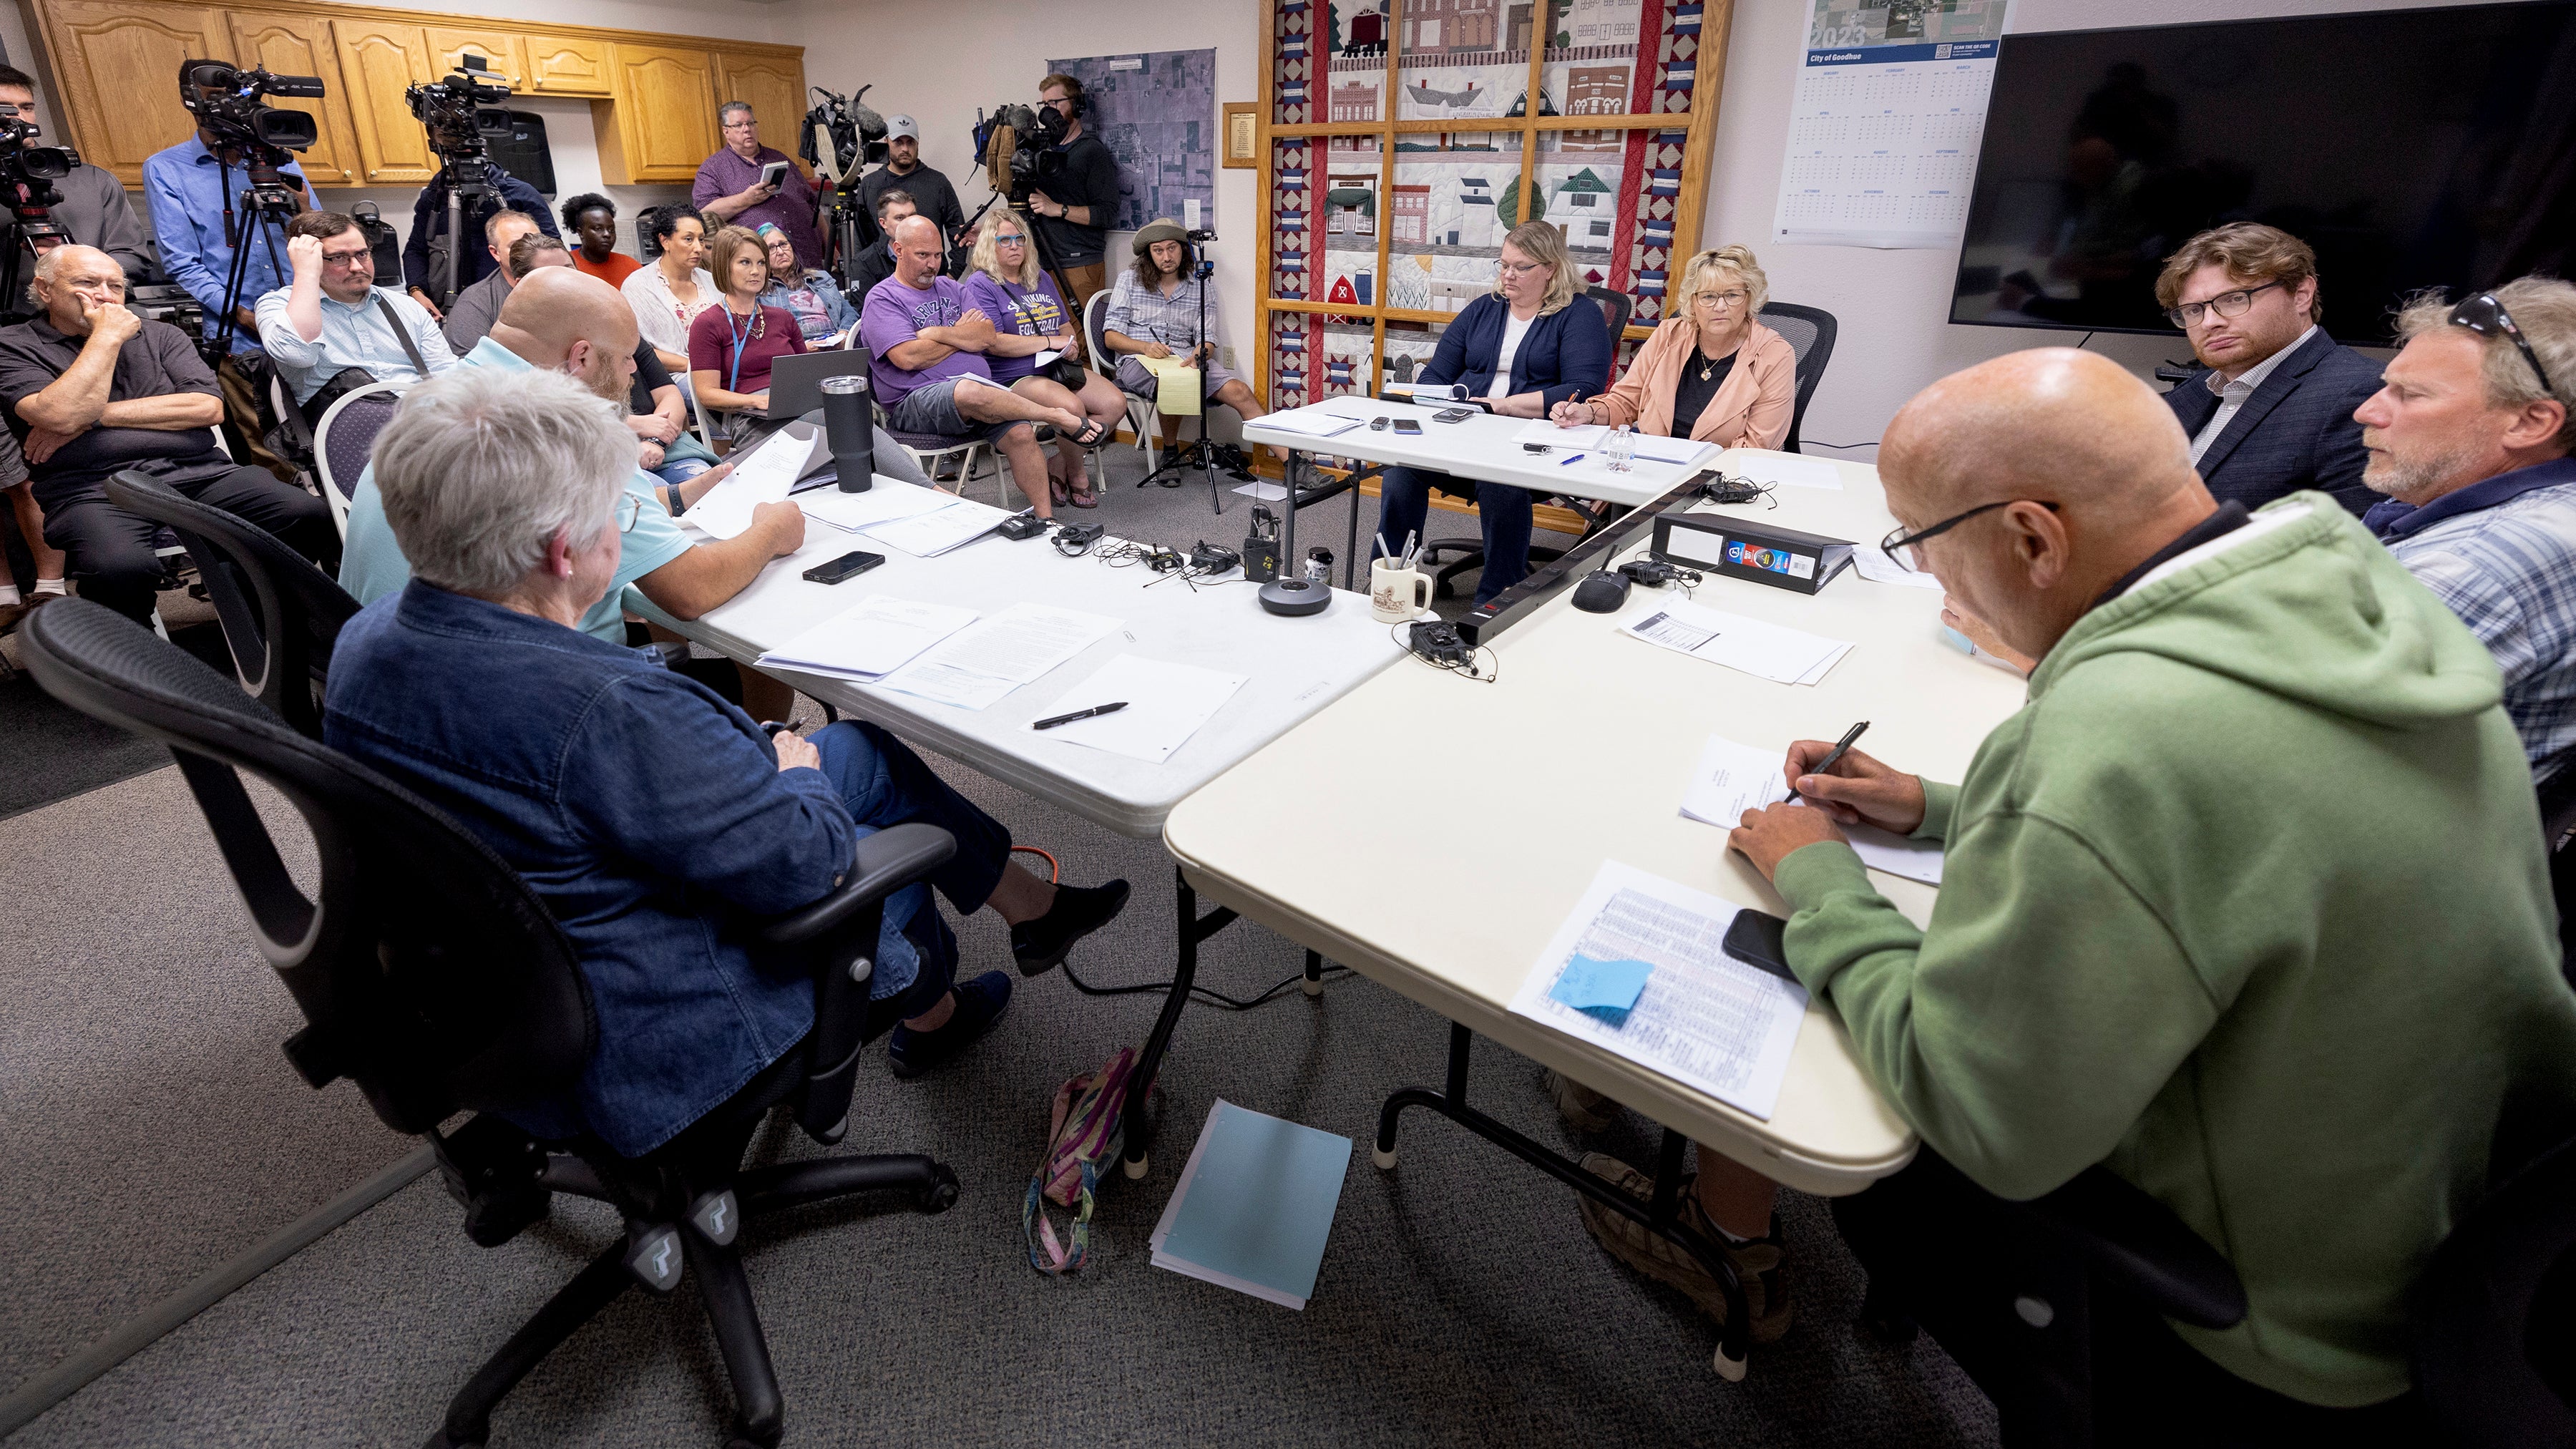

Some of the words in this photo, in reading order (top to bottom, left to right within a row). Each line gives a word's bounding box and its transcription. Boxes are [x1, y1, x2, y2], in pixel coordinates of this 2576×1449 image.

[1810, 25, 1866, 47] 2023
[1810, 55, 1823, 64] City
[1832, 52, 1862, 61] Goodhue
[912, 297, 962, 328] ARIZNA
